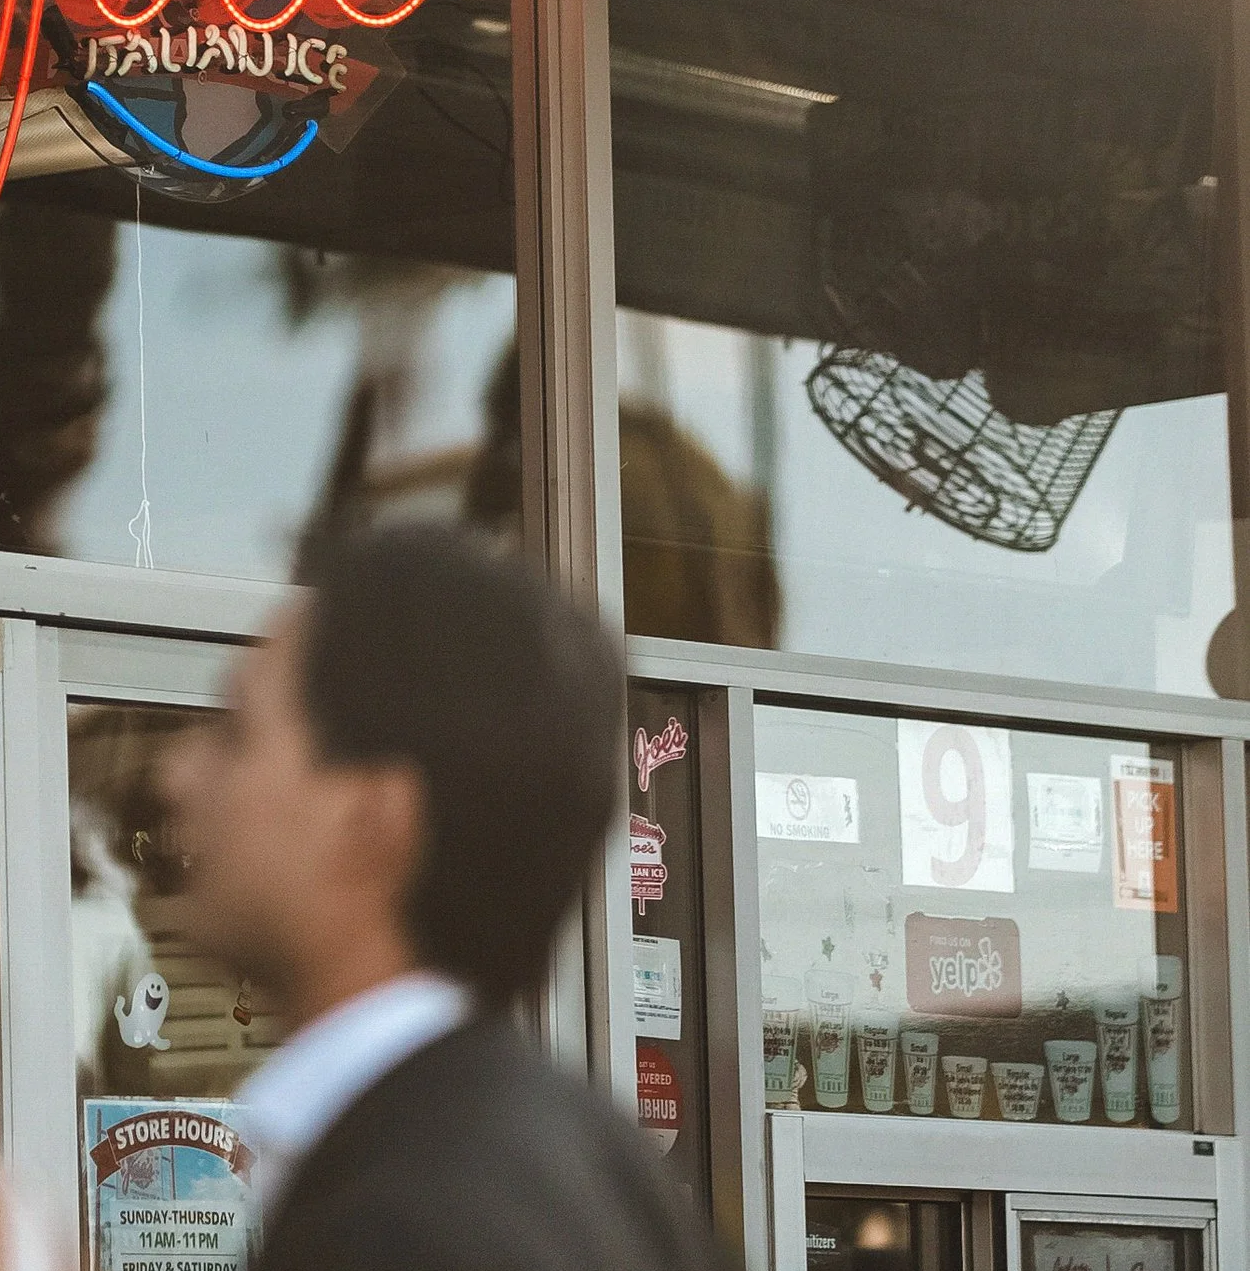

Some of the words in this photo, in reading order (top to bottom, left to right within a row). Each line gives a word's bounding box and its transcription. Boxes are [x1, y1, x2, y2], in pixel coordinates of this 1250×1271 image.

[284, 31, 349, 94] ICE
[634, 717, 688, 792] Joe's
[921, 724, 987, 887] 9
[770, 822, 783, 836] NO
[786, 824, 831, 839] SMOKING
[630, 841, 657, 854] oe's
[1127, 840, 1164, 861] HERE
[651, 868, 664, 878] ICE
[929, 951, 979, 998] yelp
[115, 1118, 170, 1150] STORE
[174, 1117, 234, 1152] HOURS
[120, 1210, 235, 1226] SUNDAY-THURSDAY
